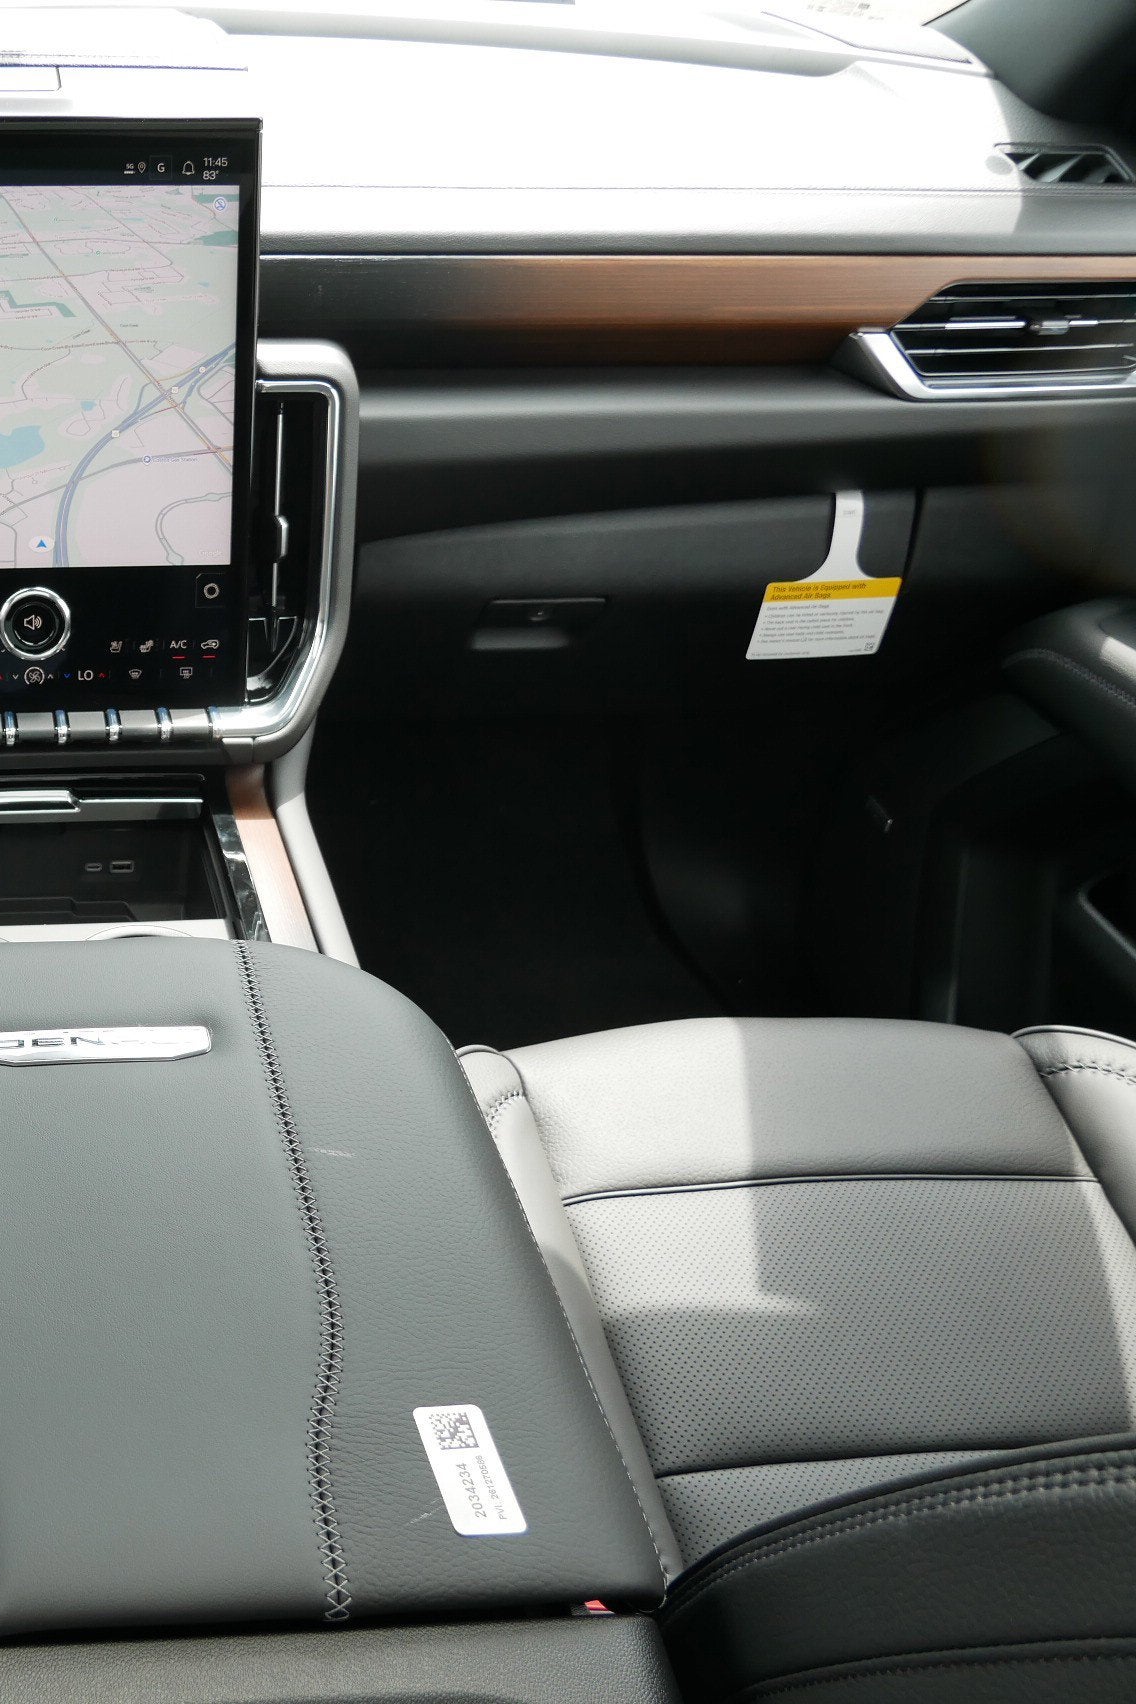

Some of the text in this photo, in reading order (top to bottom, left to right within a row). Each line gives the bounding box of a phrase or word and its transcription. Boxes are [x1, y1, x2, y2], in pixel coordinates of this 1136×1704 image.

[203, 157, 228, 167] 11:45
[170, 640, 187, 649] A/C
[77, 669, 93, 681] LO
[455, 1462, 487, 1518] 2034234
